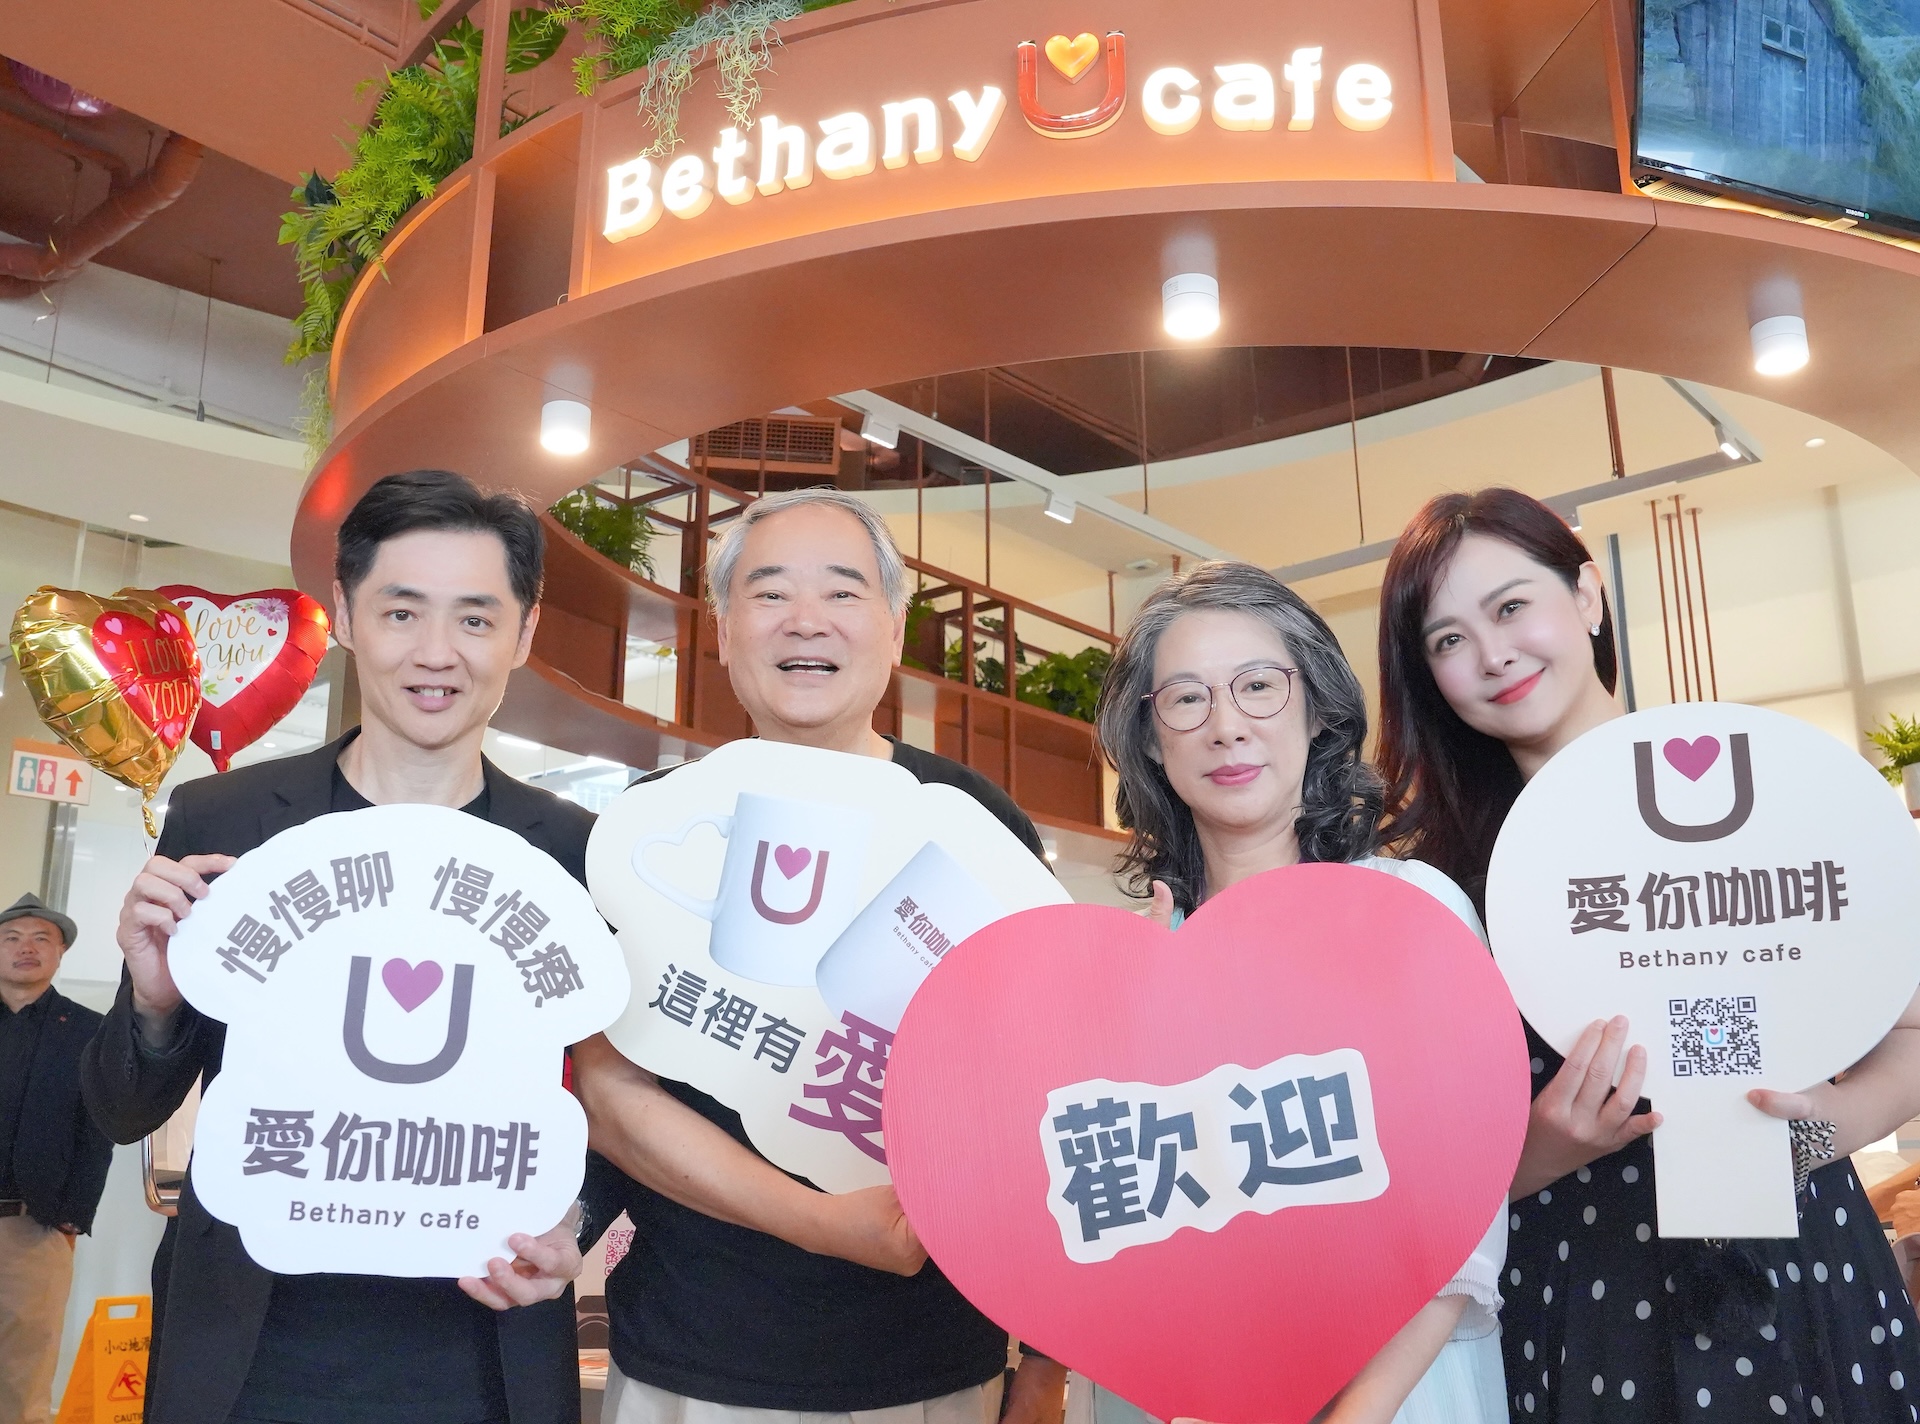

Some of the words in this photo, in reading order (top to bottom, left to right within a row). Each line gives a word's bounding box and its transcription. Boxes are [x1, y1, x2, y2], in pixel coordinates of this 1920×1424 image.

[602, 84, 1006, 243] Bethany
[1141, 46, 1393, 134] cafe
[125, 639, 144, 677] I
[142, 638, 192, 675] LOVE
[194, 608, 261, 649] Love
[1634, 733, 1754, 842] U
[215, 850, 395, 985] 慢慢聊
[429, 856, 585, 1009] 慢慢療
[893, 895, 956, 960] 愛你咖
[1567, 860, 1849, 935] 愛你咖啡
[892, 925, 920, 955] Bethany
[1619, 949, 1729, 969] Bethany
[1742, 943, 1803, 963] cafe
[343, 955, 475, 1085] U
[242, 1107, 540, 1191] 愛你咖啡
[1052, 1071, 1365, 1243] 歡迎
[288, 1200, 406, 1228] Bethany
[419, 1209, 480, 1230] cafe
